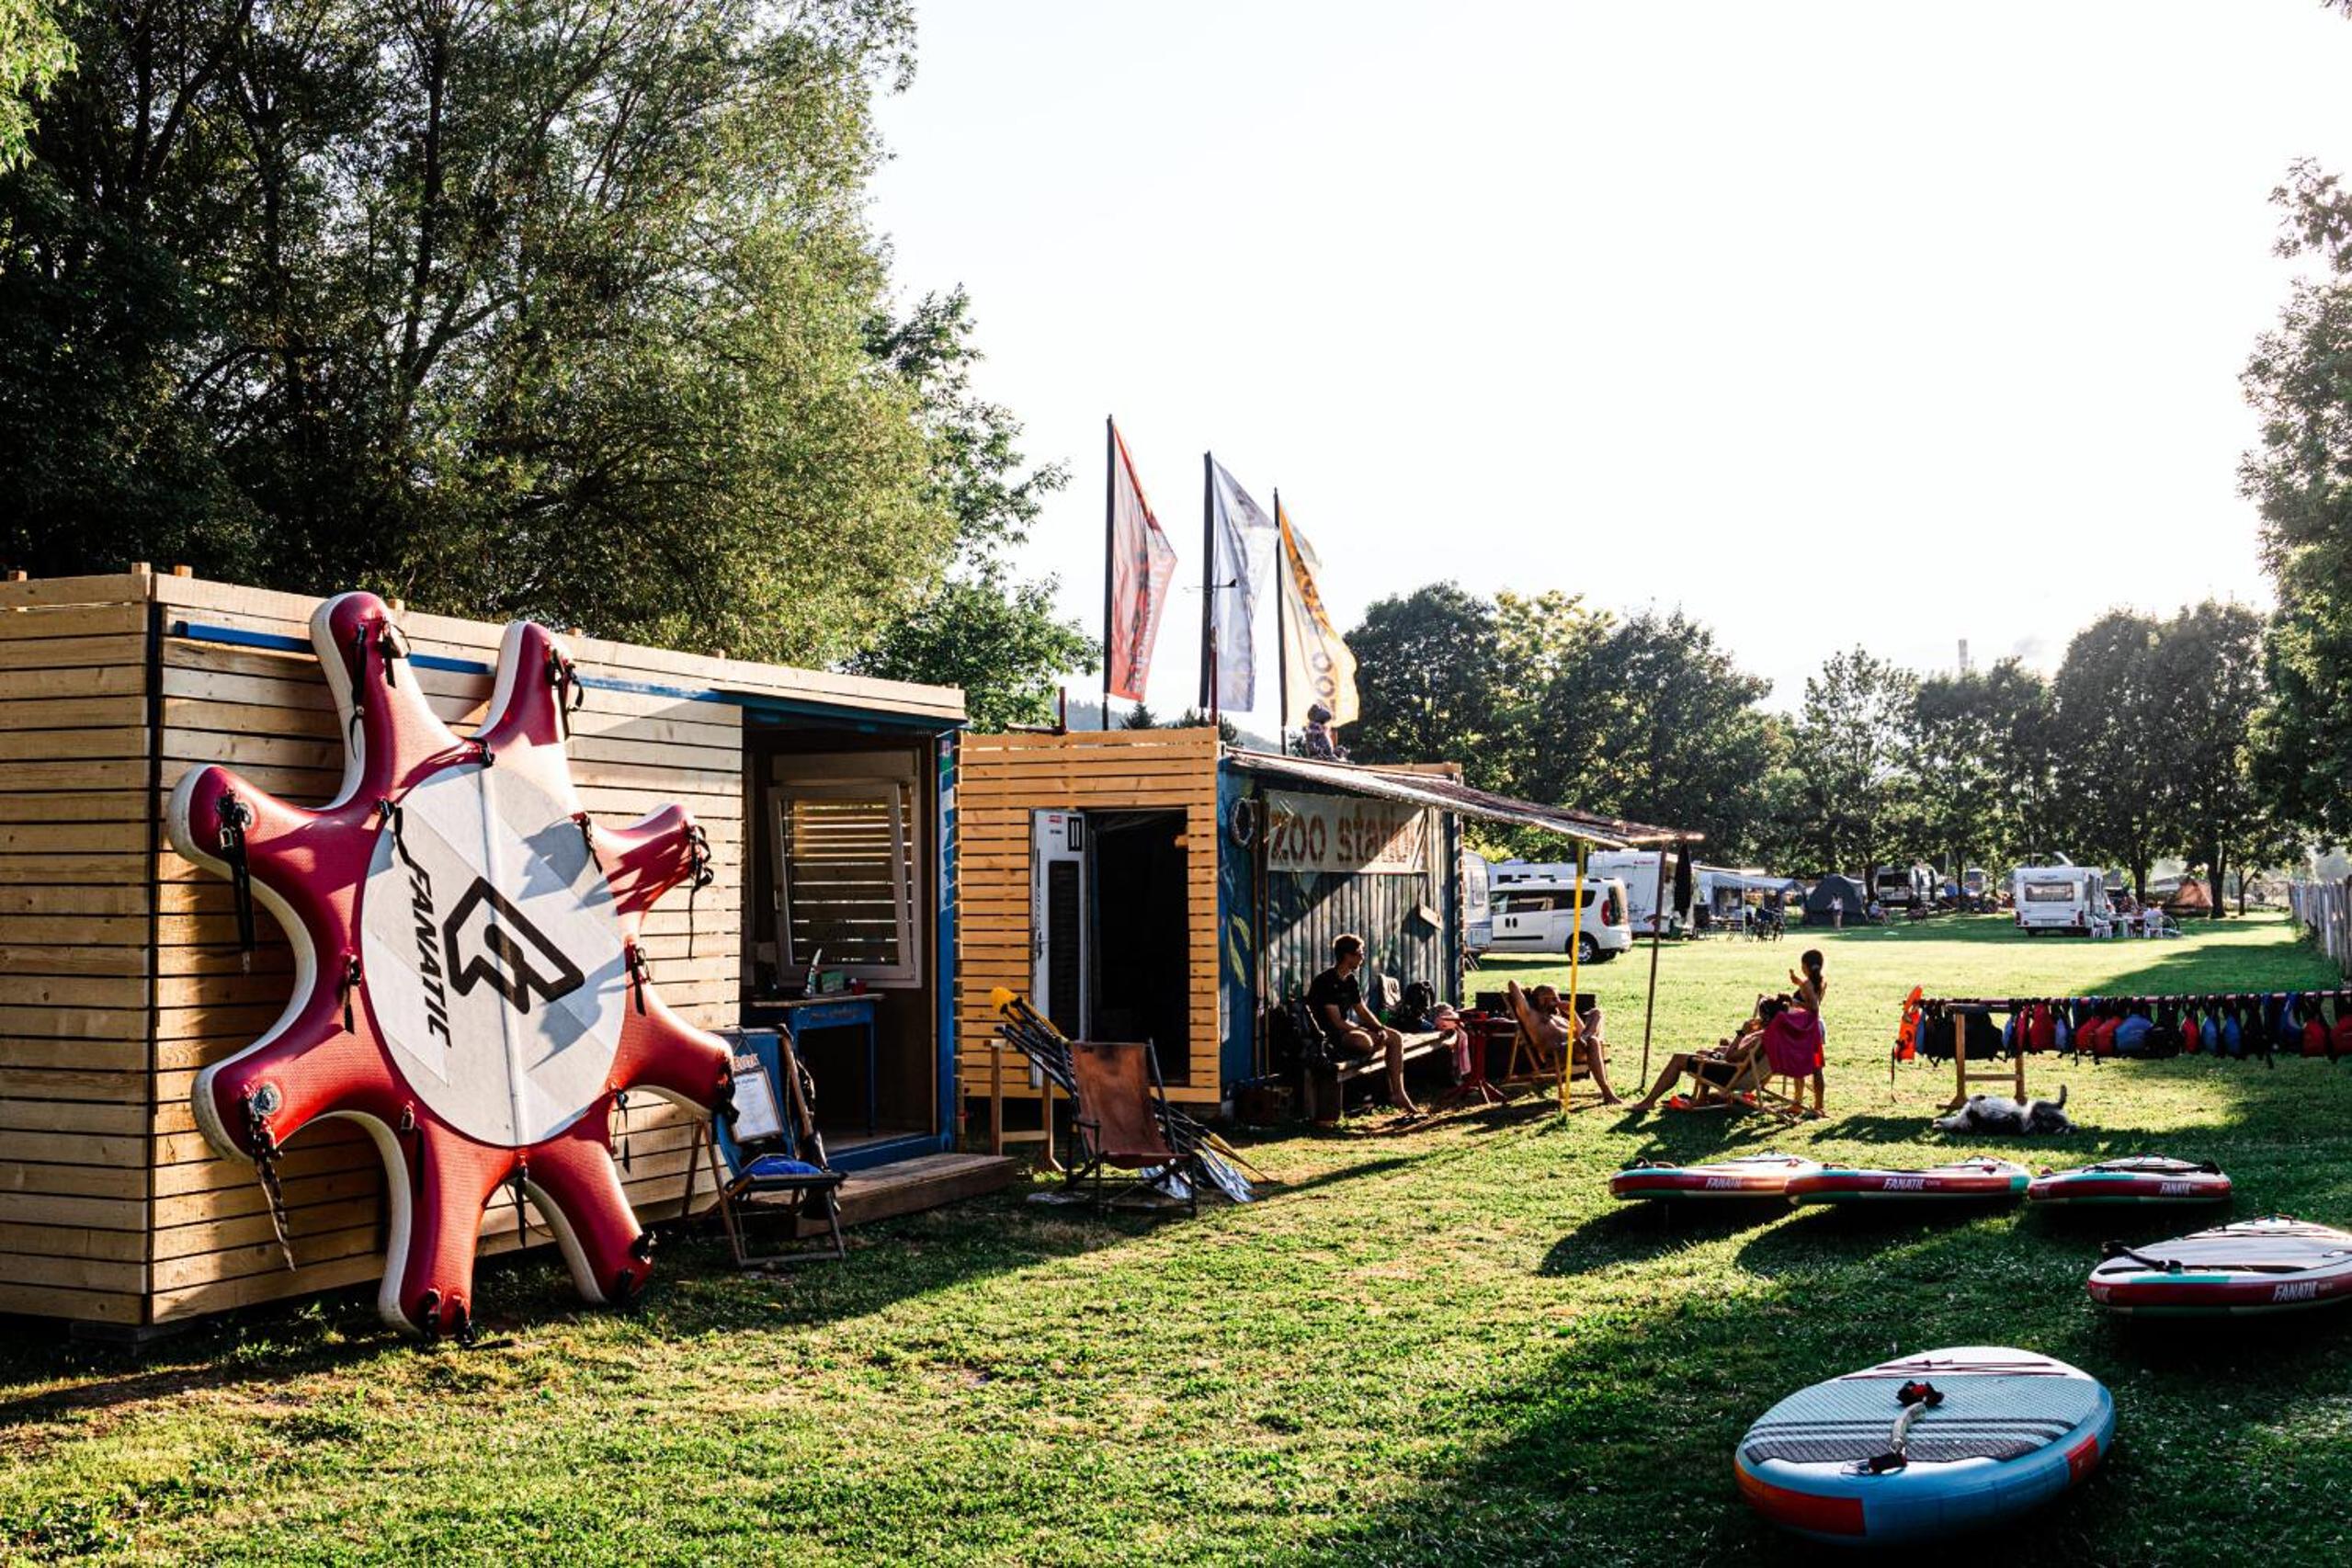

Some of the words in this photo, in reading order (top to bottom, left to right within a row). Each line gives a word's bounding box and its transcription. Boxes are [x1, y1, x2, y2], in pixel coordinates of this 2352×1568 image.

[403, 860, 451, 1048] FANATIC
[1883, 1177, 1926, 1190] FANATIC
[2160, 1181, 2191, 1196] FANATIC
[2272, 1280, 2318, 1301] FANATIC
